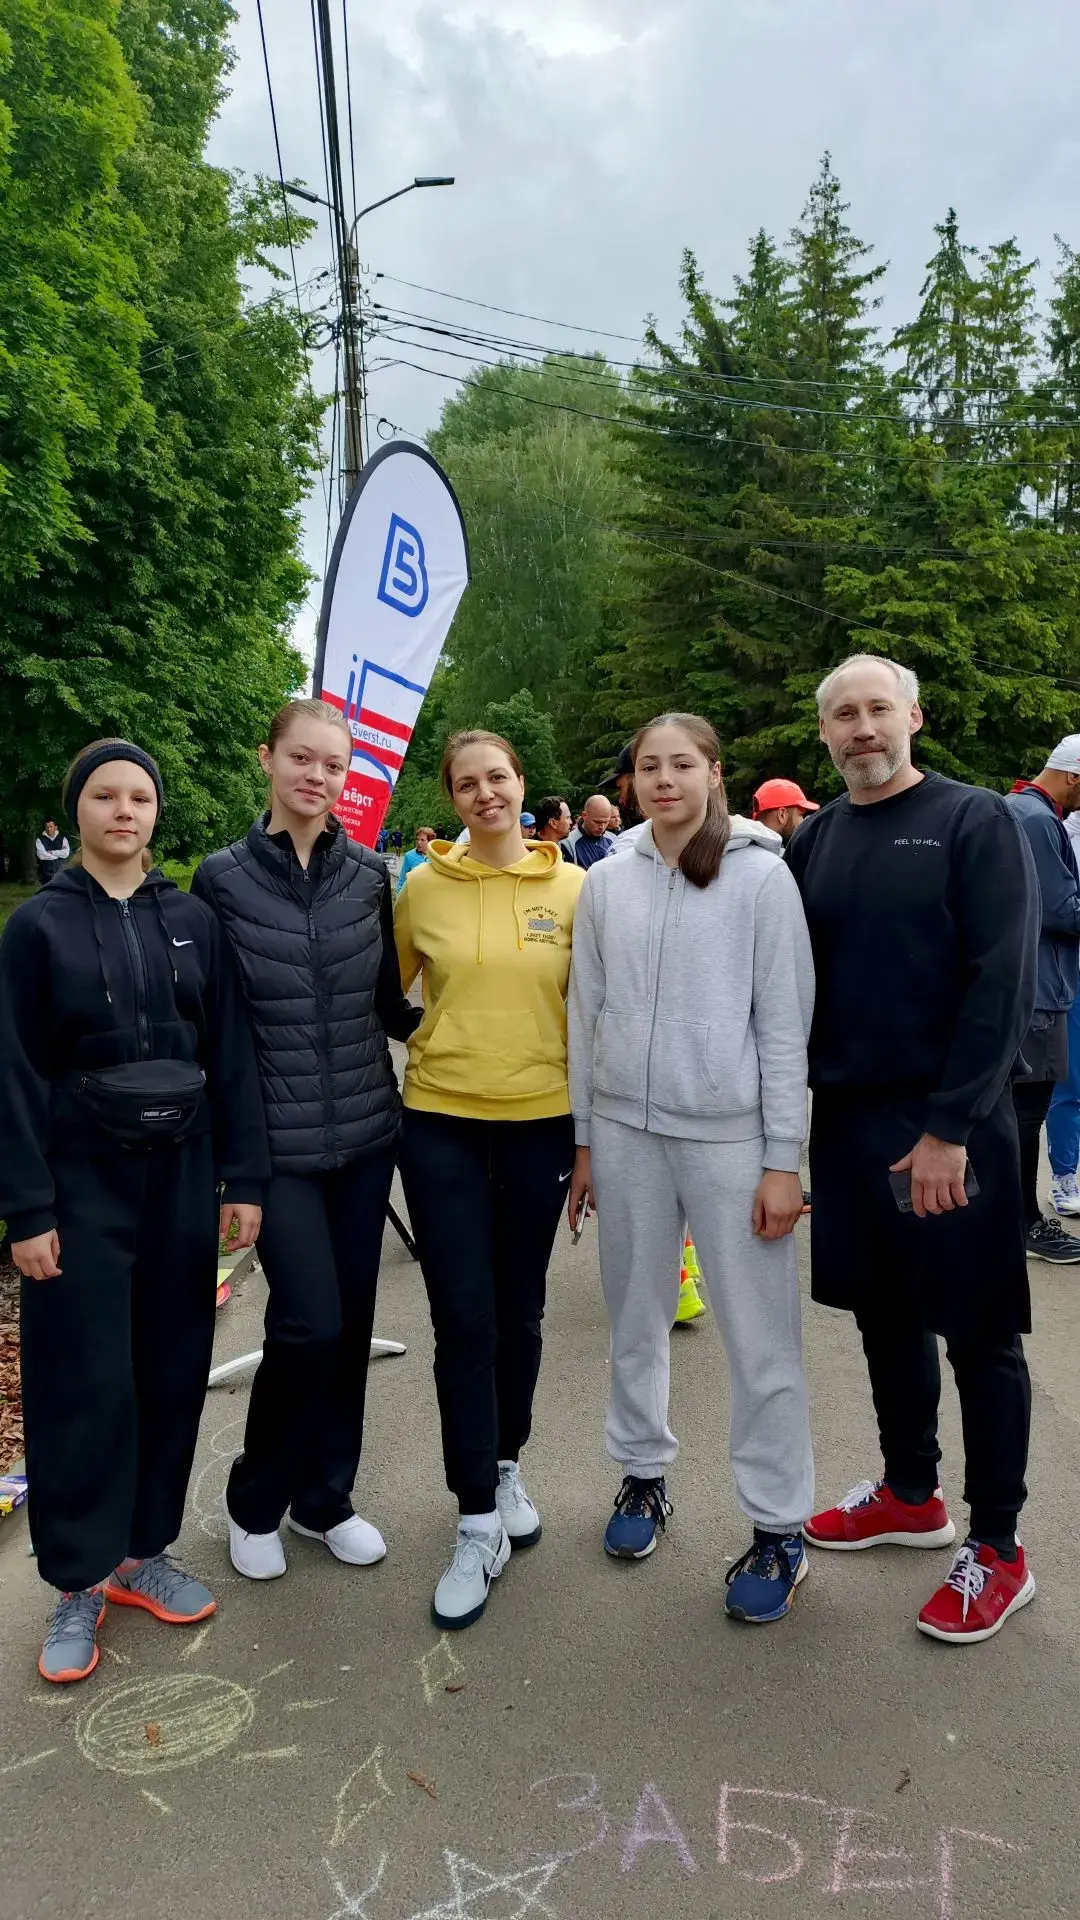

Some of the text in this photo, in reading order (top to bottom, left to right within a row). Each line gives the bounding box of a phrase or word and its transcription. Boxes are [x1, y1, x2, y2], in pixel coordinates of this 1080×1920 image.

[352, 722, 392, 748] 5verst.ru
[343, 787, 374, 807] вёрст
[922, 838, 941, 847] HEAL
[544, 907, 559, 917] LAZY
[526, 1772, 1033, 1920] ЗАБЕГ
